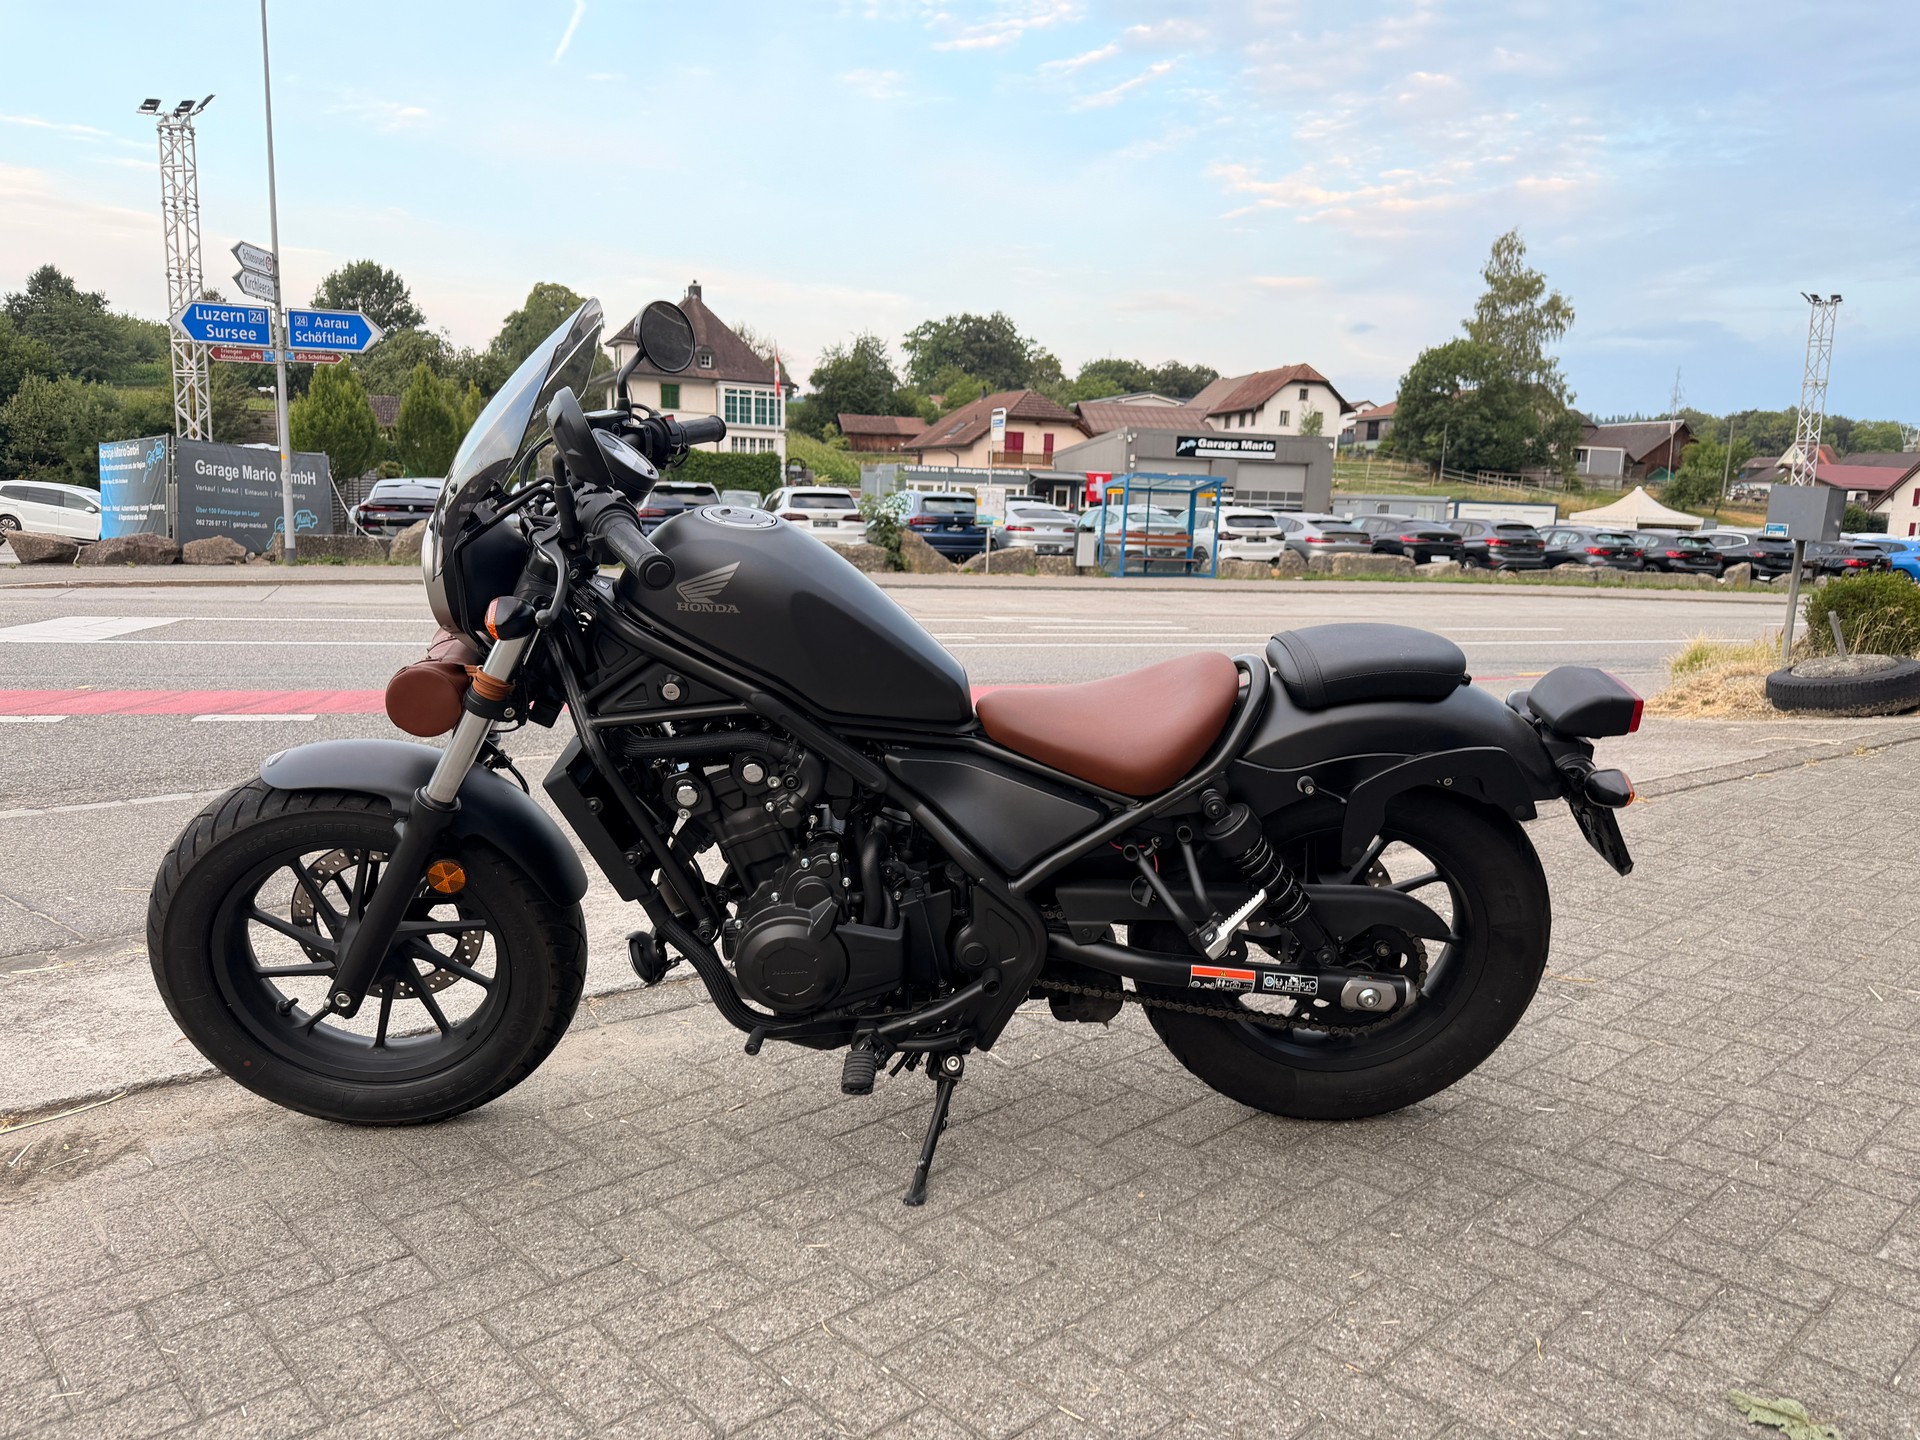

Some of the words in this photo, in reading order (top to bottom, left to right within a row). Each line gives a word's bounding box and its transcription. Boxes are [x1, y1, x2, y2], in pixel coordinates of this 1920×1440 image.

[244, 274, 274, 297] Kirchleerau
[195, 306, 245, 323] Luzern
[251, 312, 263, 322] 24
[296, 317, 307, 326] 24
[314, 317, 349, 329] Aarau
[206, 324, 257, 341] Sursee
[295, 330, 358, 345] Schöftland
[1197, 438, 1239, 451] Garage
[1241, 440, 1275, 451] Mario
[194, 459, 239, 481] Garage
[242, 465, 277, 482] Mario
[195, 484, 216, 492] Verkauf
[221, 486, 239, 494] Ankauf
[244, 488, 269, 497] Eintausch
[274, 490, 306, 500] Finerung
[195, 505, 207, 513] Über
[217, 507, 241, 516] Fahrzeuge
[247, 510, 260, 518] Lager
[195, 518, 205, 526] 062
[232, 521, 268, 529] garage-mario.ch
[676, 602, 741, 614] HONDA
